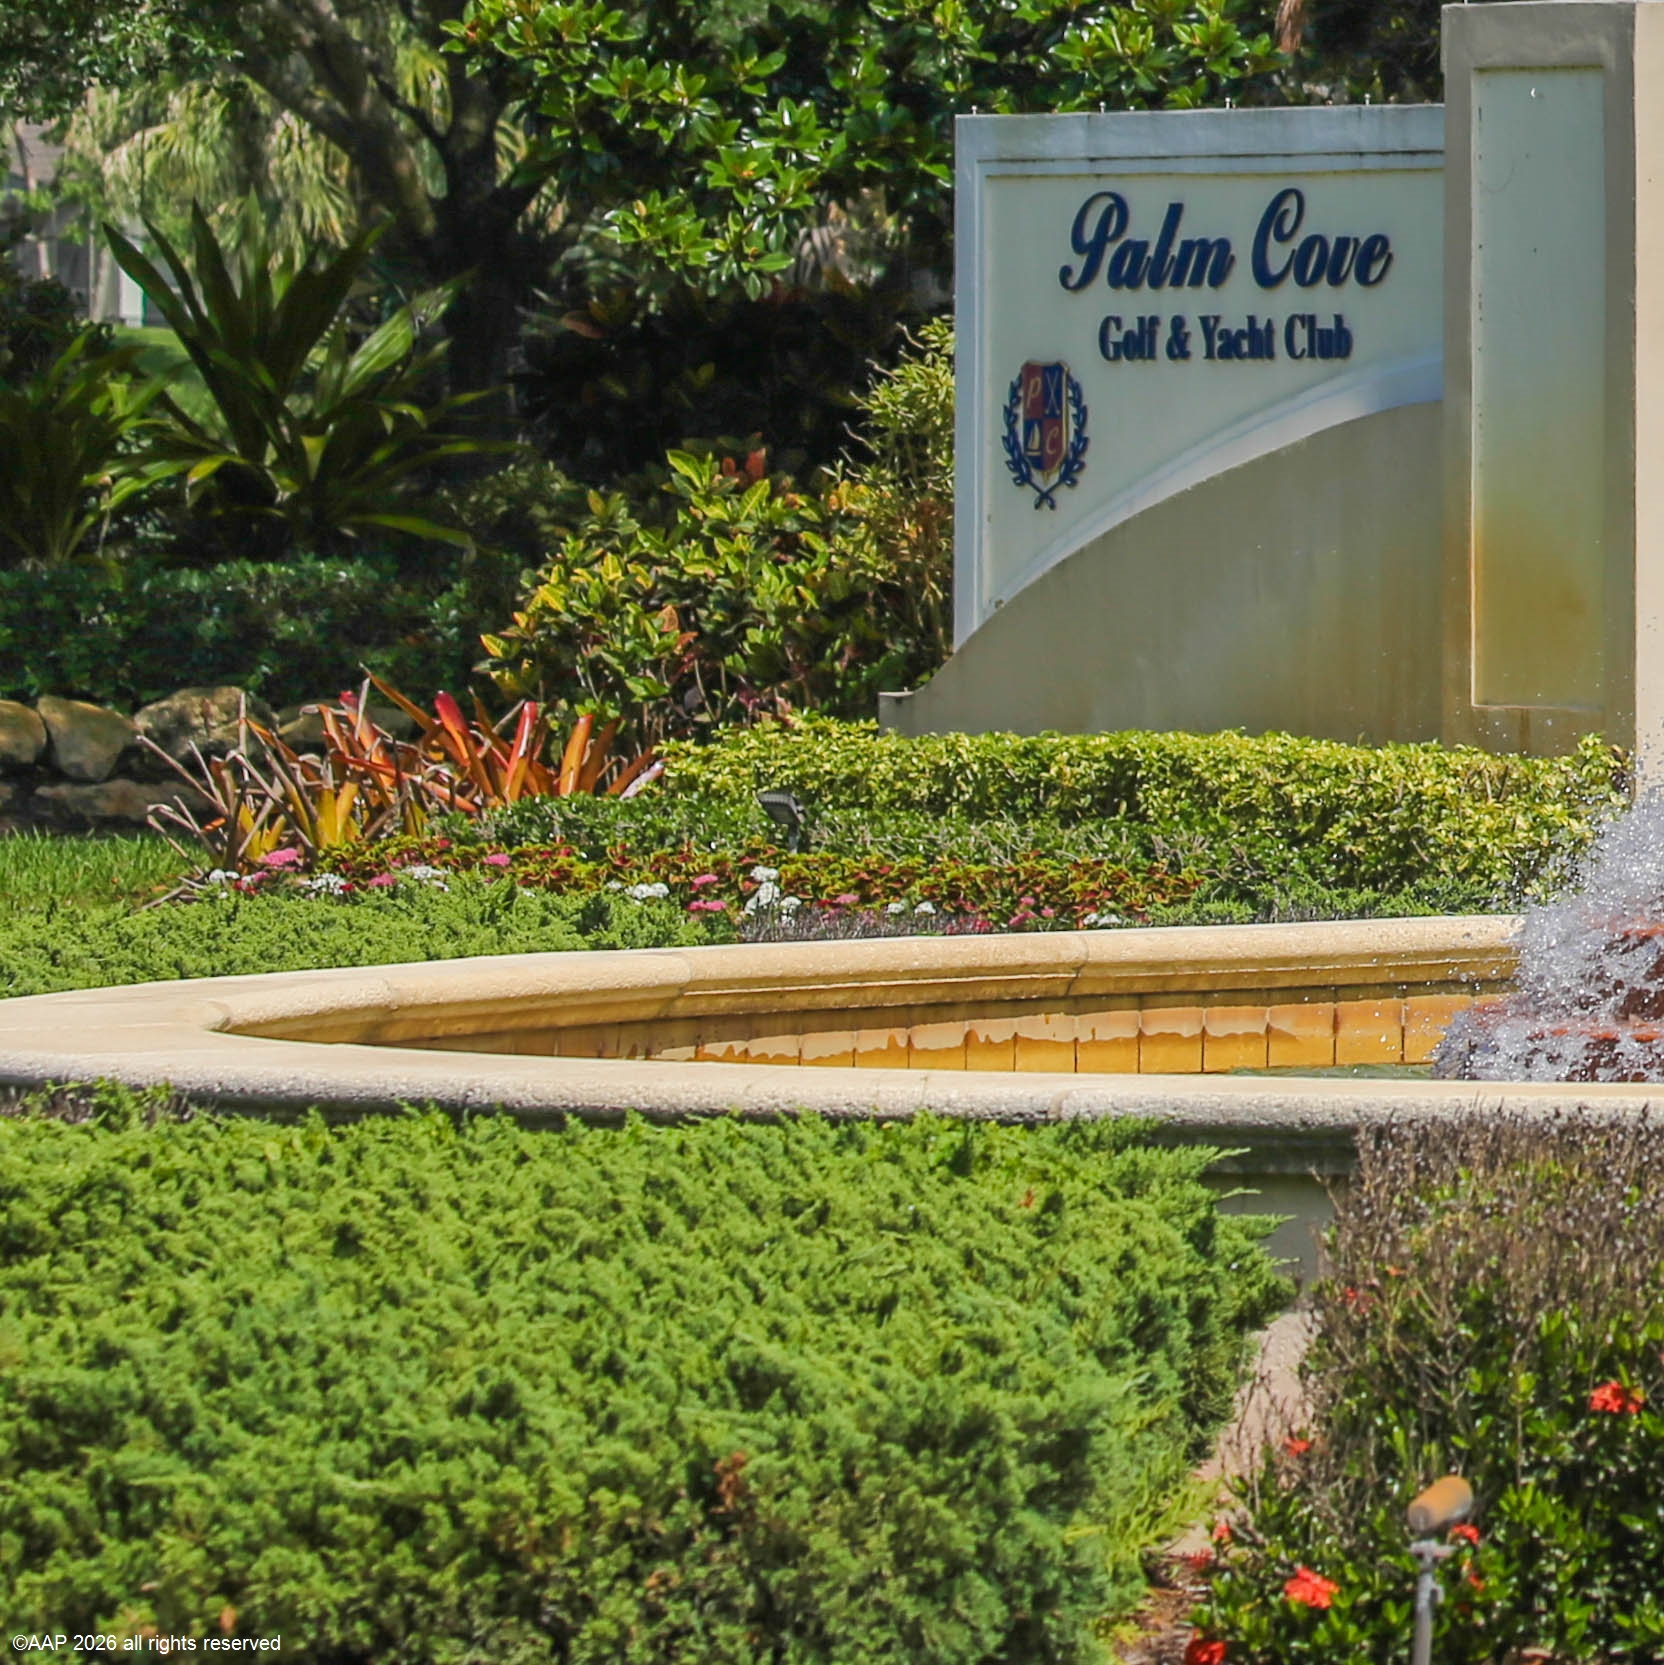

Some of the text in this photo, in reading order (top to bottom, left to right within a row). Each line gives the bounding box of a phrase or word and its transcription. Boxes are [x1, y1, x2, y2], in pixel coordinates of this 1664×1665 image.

[1059, 188, 1394, 292] Palm Cove
[1099, 314, 1354, 361] Golf & Yacht Club
